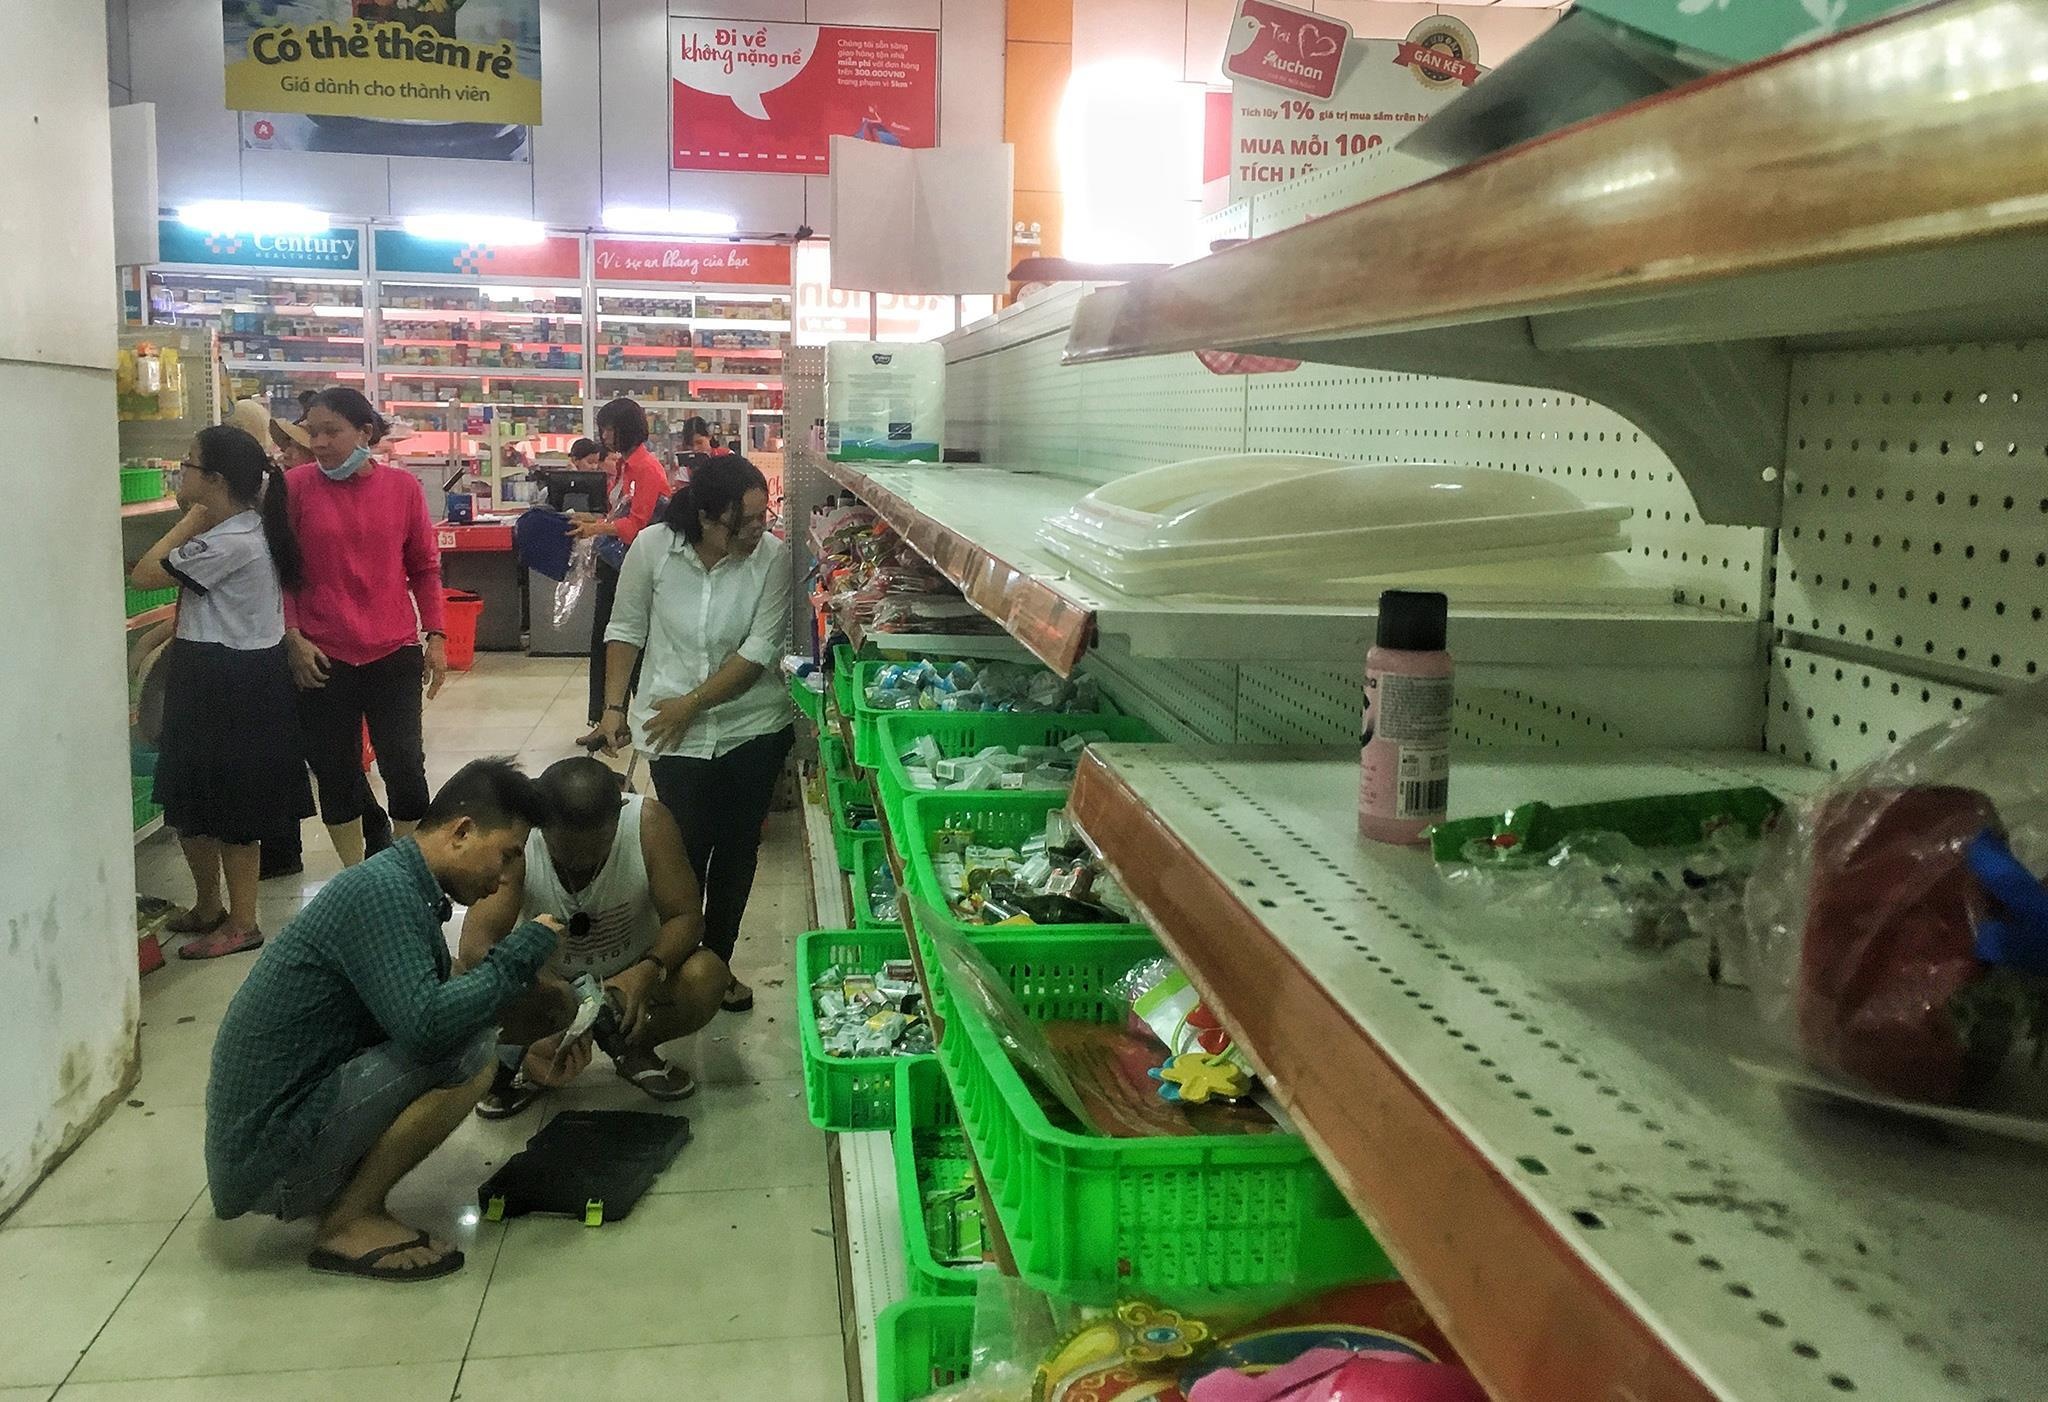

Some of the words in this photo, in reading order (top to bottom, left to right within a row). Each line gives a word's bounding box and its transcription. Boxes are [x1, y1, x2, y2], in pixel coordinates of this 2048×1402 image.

[715, 28, 737, 46] Đi
[743, 27, 768, 48] về
[252, 28, 302, 65] Có
[306, 22, 369, 60] thẻ
[374, 27, 470, 70] thêm
[475, 43, 513, 80] rẻ
[681, 33, 734, 75] không
[737, 50, 778, 68] nặng
[1262, 49, 1324, 81] Auchan
[280, 75, 310, 93] Giá
[315, 77, 360, 96] dành
[364, 80, 396, 98] cho
[400, 81, 451, 101] thành
[455, 85, 490, 102] viên
[1241, 107, 1261, 117] Tích
[1263, 107, 1278, 120] lũy
[1280, 100, 1315, 121] 1%
[1319, 109, 1334, 121] giá
[1336, 110, 1348, 122] trị
[1350, 113, 1371, 121] mua
[1373, 110, 1393, 121] sắm
[1395, 111, 1416, 122] trên
[1240, 138, 1285, 154] MUA
[1290, 134, 1328, 156] MỖI
[1240, 162, 1284, 182] TÍCH
[253, 231, 356, 260] Century
[644, 258, 659, 268] an
[662, 249, 700, 275] khang
[727, 249, 750, 269] bạn
